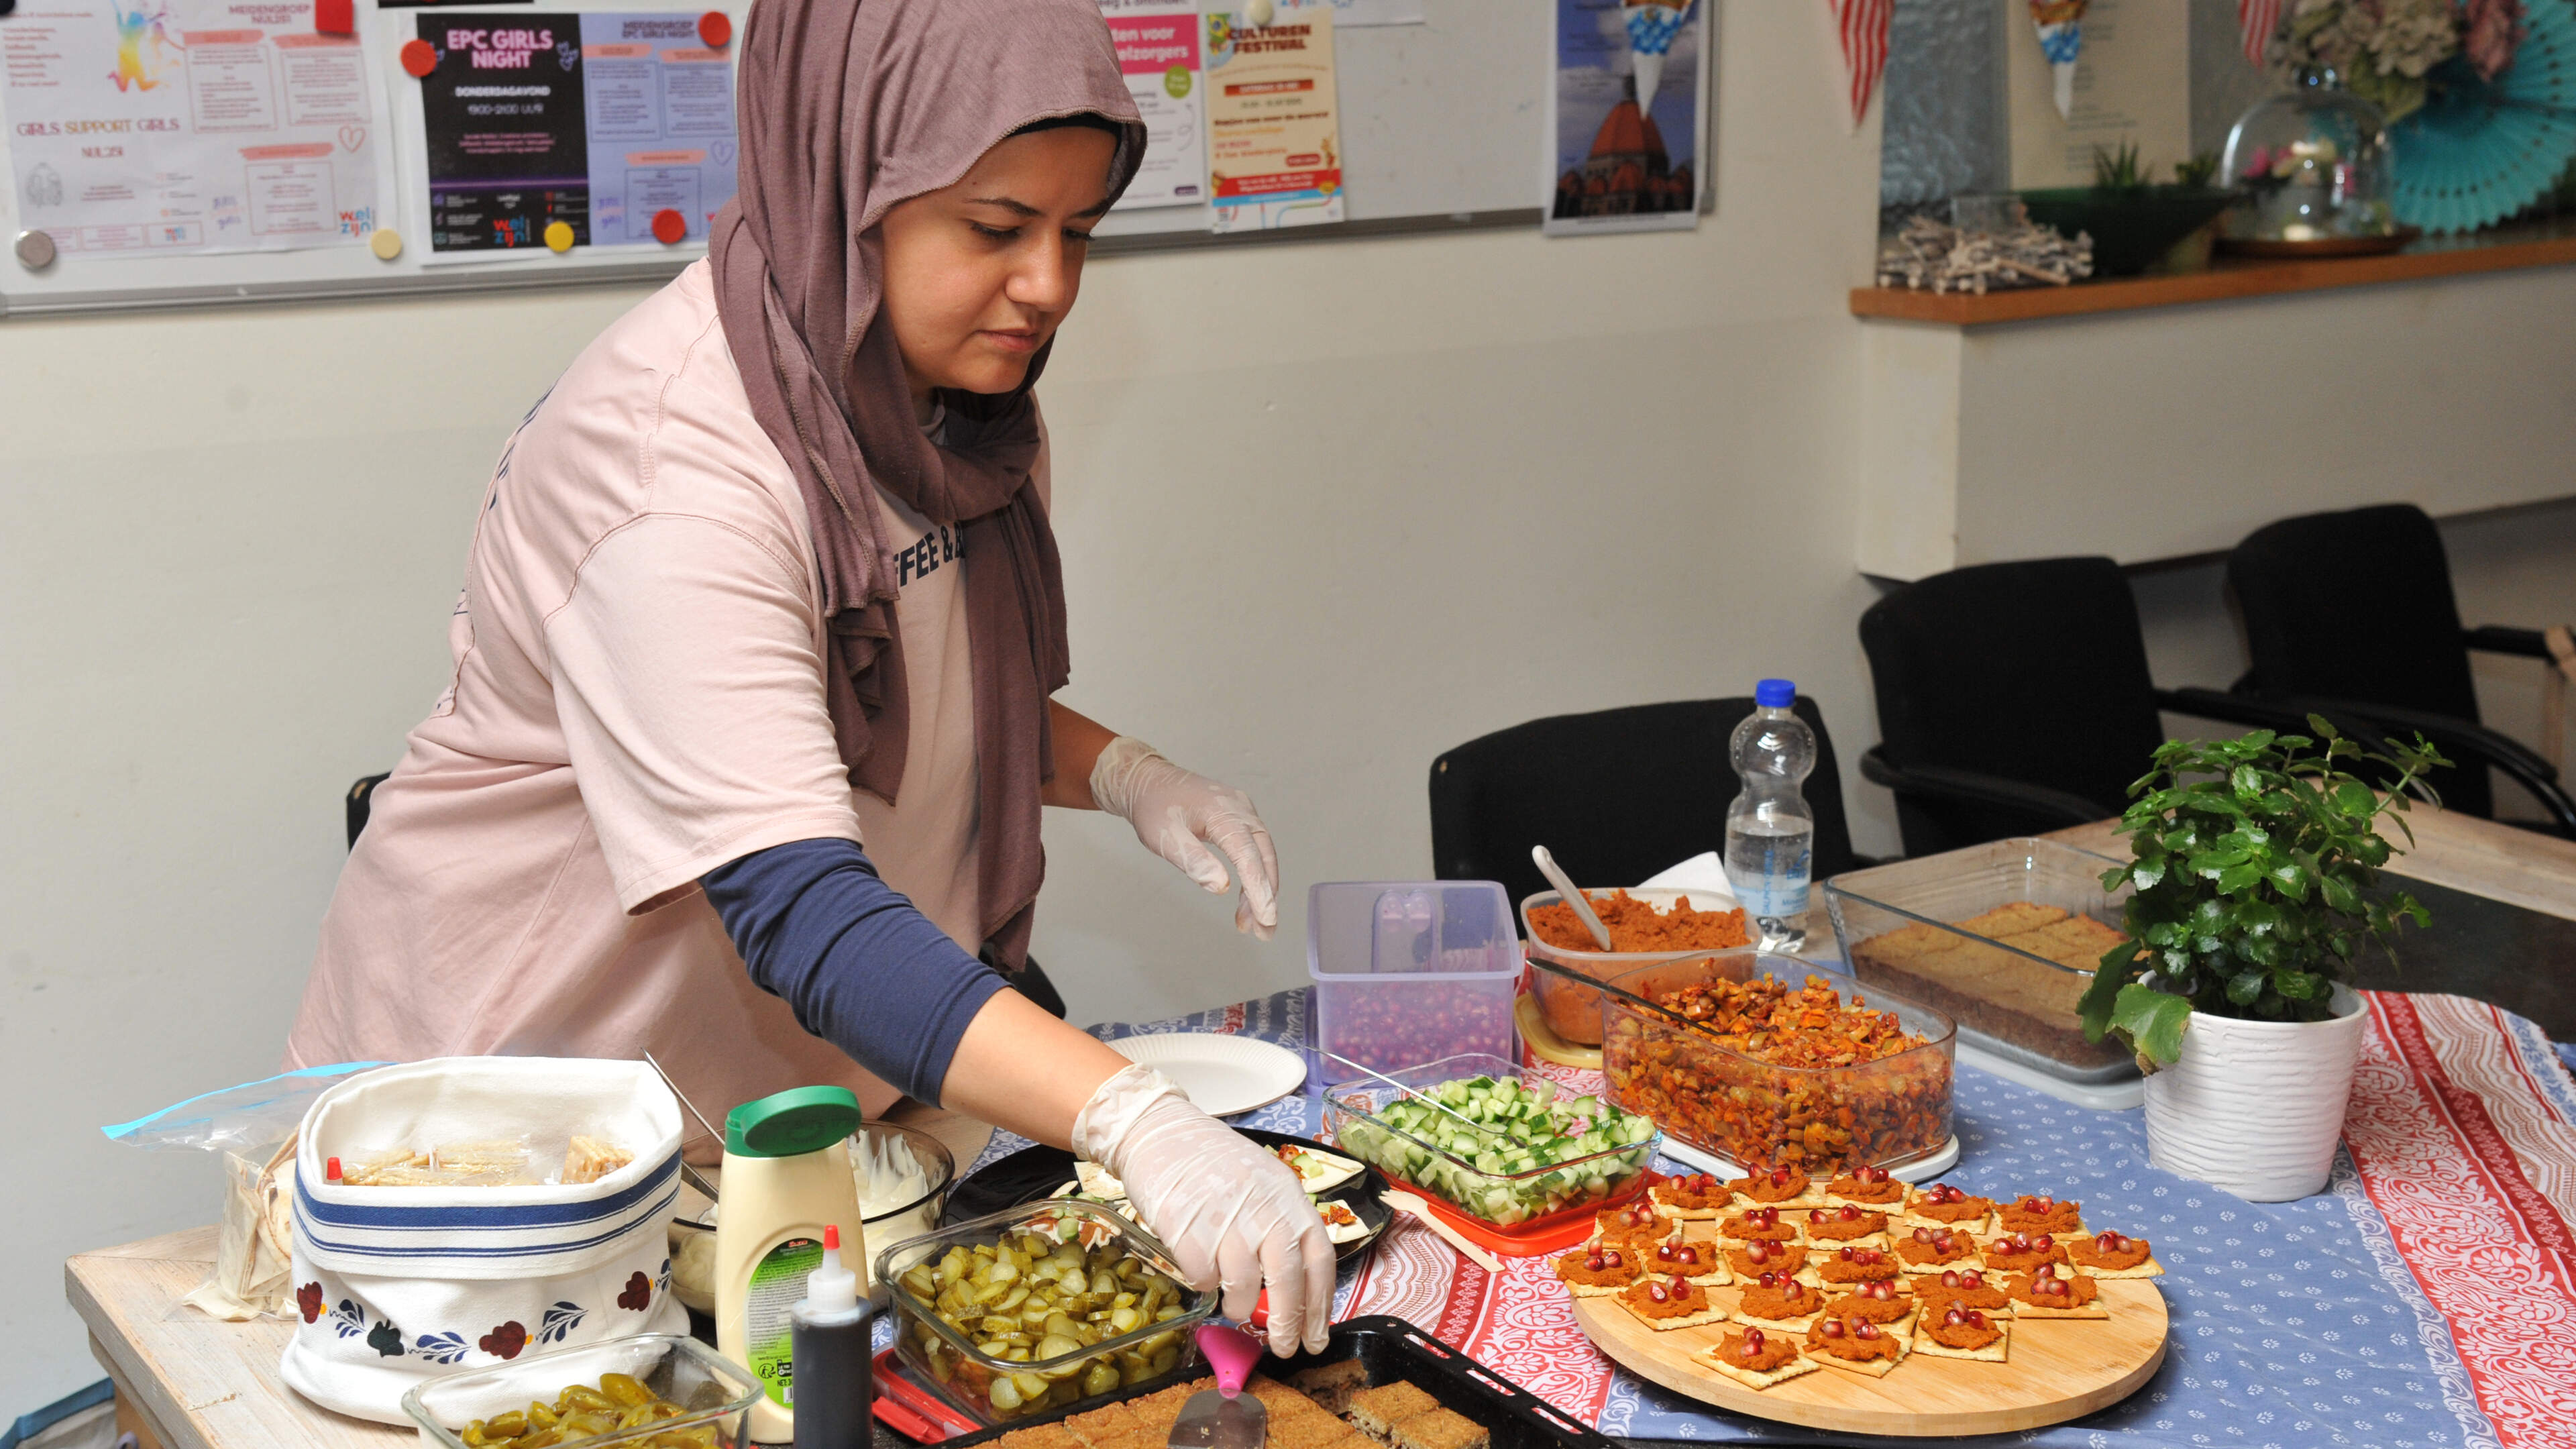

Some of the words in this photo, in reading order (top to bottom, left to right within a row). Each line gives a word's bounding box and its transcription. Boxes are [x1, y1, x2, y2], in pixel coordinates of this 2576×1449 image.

[446, 30, 488, 50] EPC
[491, 29, 554, 50] GIRLS
[1110, 29, 1140, 42] ten
[1140, 27, 1175, 41] voor
[1118, 46, 1189, 63] elzorgers
[1233, 39, 1307, 54] FESTIVAL
[471, 50, 532, 69] NIGHT
[17, 121, 61, 136] GIRLS
[64, 119, 131, 134] SUPPORT
[137, 119, 181, 132] GIRLS
[493, 215, 526, 231] wel
[494, 229, 526, 248] zijn
[941, 525, 954, 563] &
